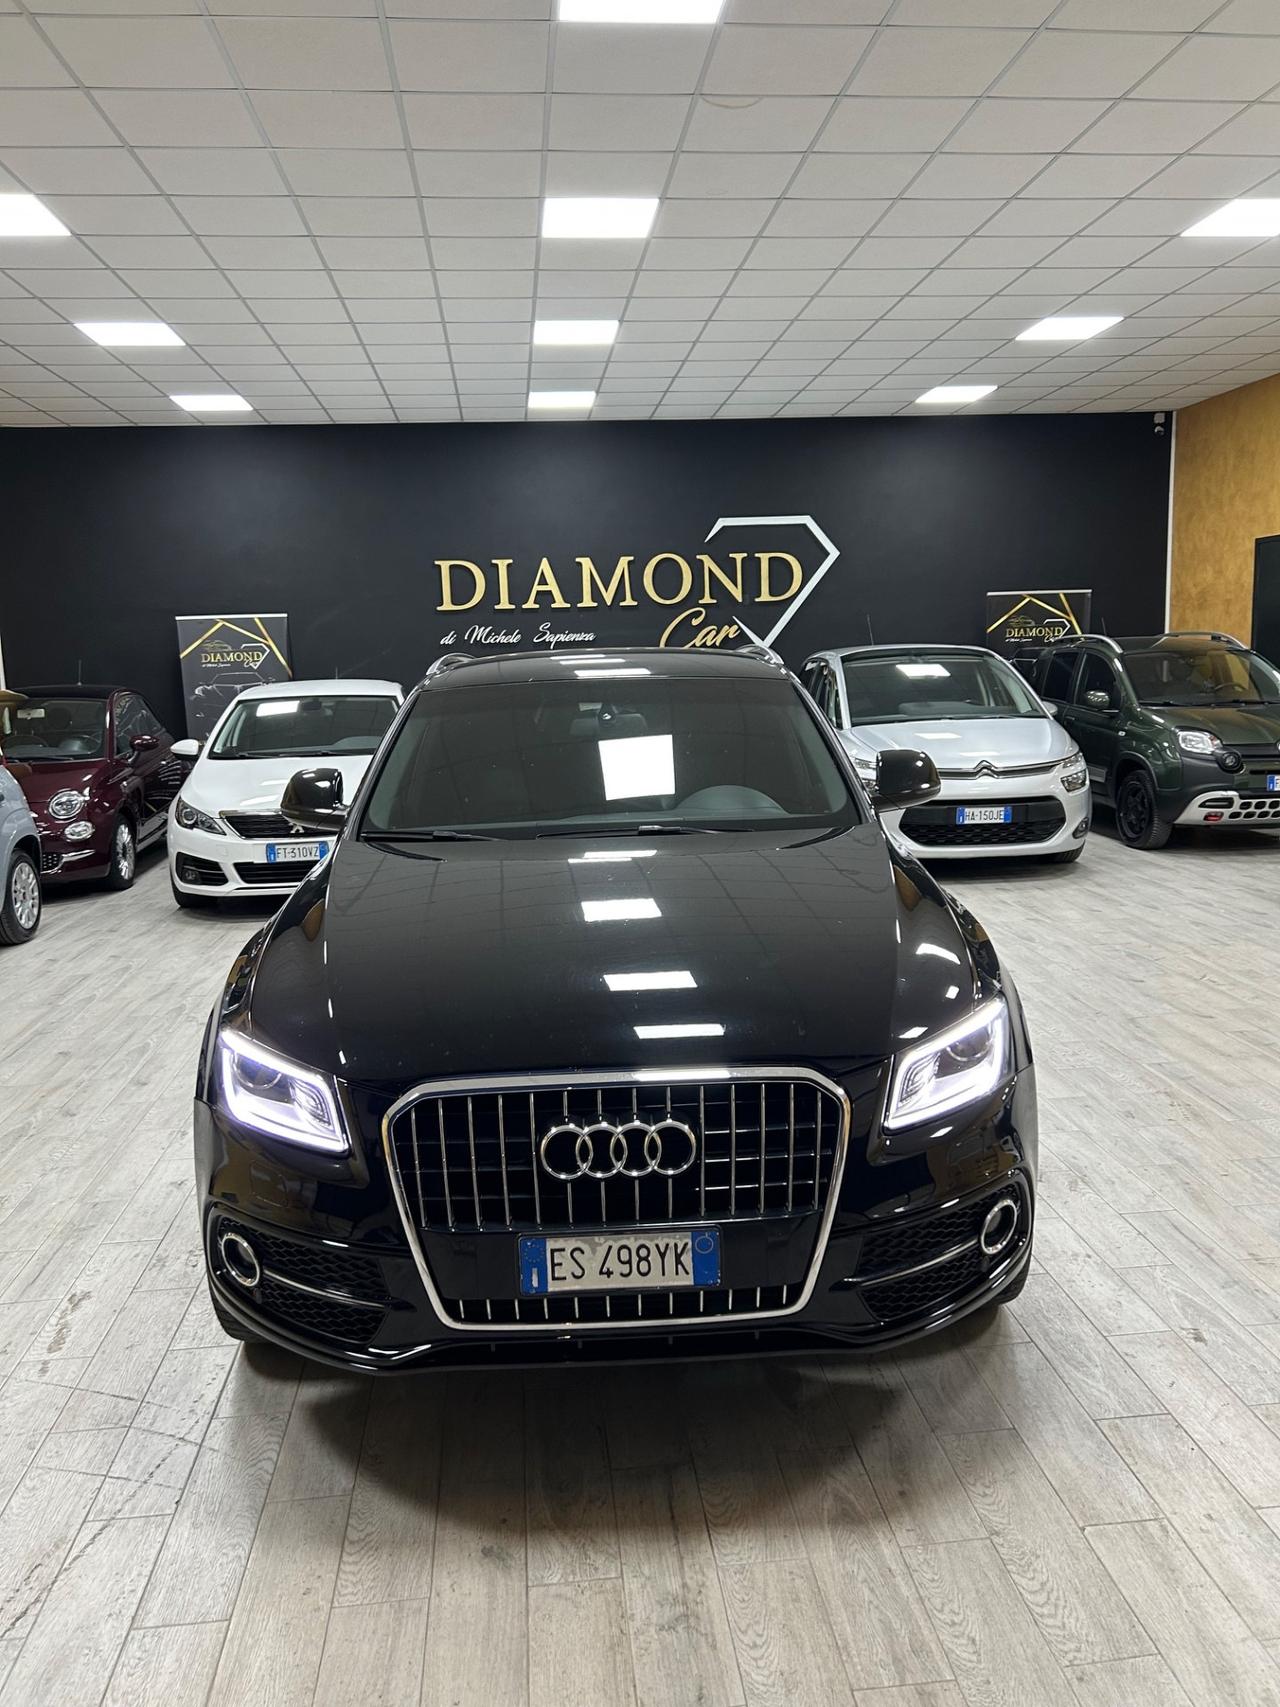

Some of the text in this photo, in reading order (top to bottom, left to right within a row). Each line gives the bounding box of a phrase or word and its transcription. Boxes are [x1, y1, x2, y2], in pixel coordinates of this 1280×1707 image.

[434, 551, 803, 611] DIAMOND
[440, 621, 597, 650] di Michele Sapienza
[659, 607, 741, 649] Car
[1006, 627, 1063, 637] DIAMOND
[201, 652, 263, 663] DIAMOND
[550, 1246, 586, 1281] ES
[598, 1241, 690, 1279] 498YK
